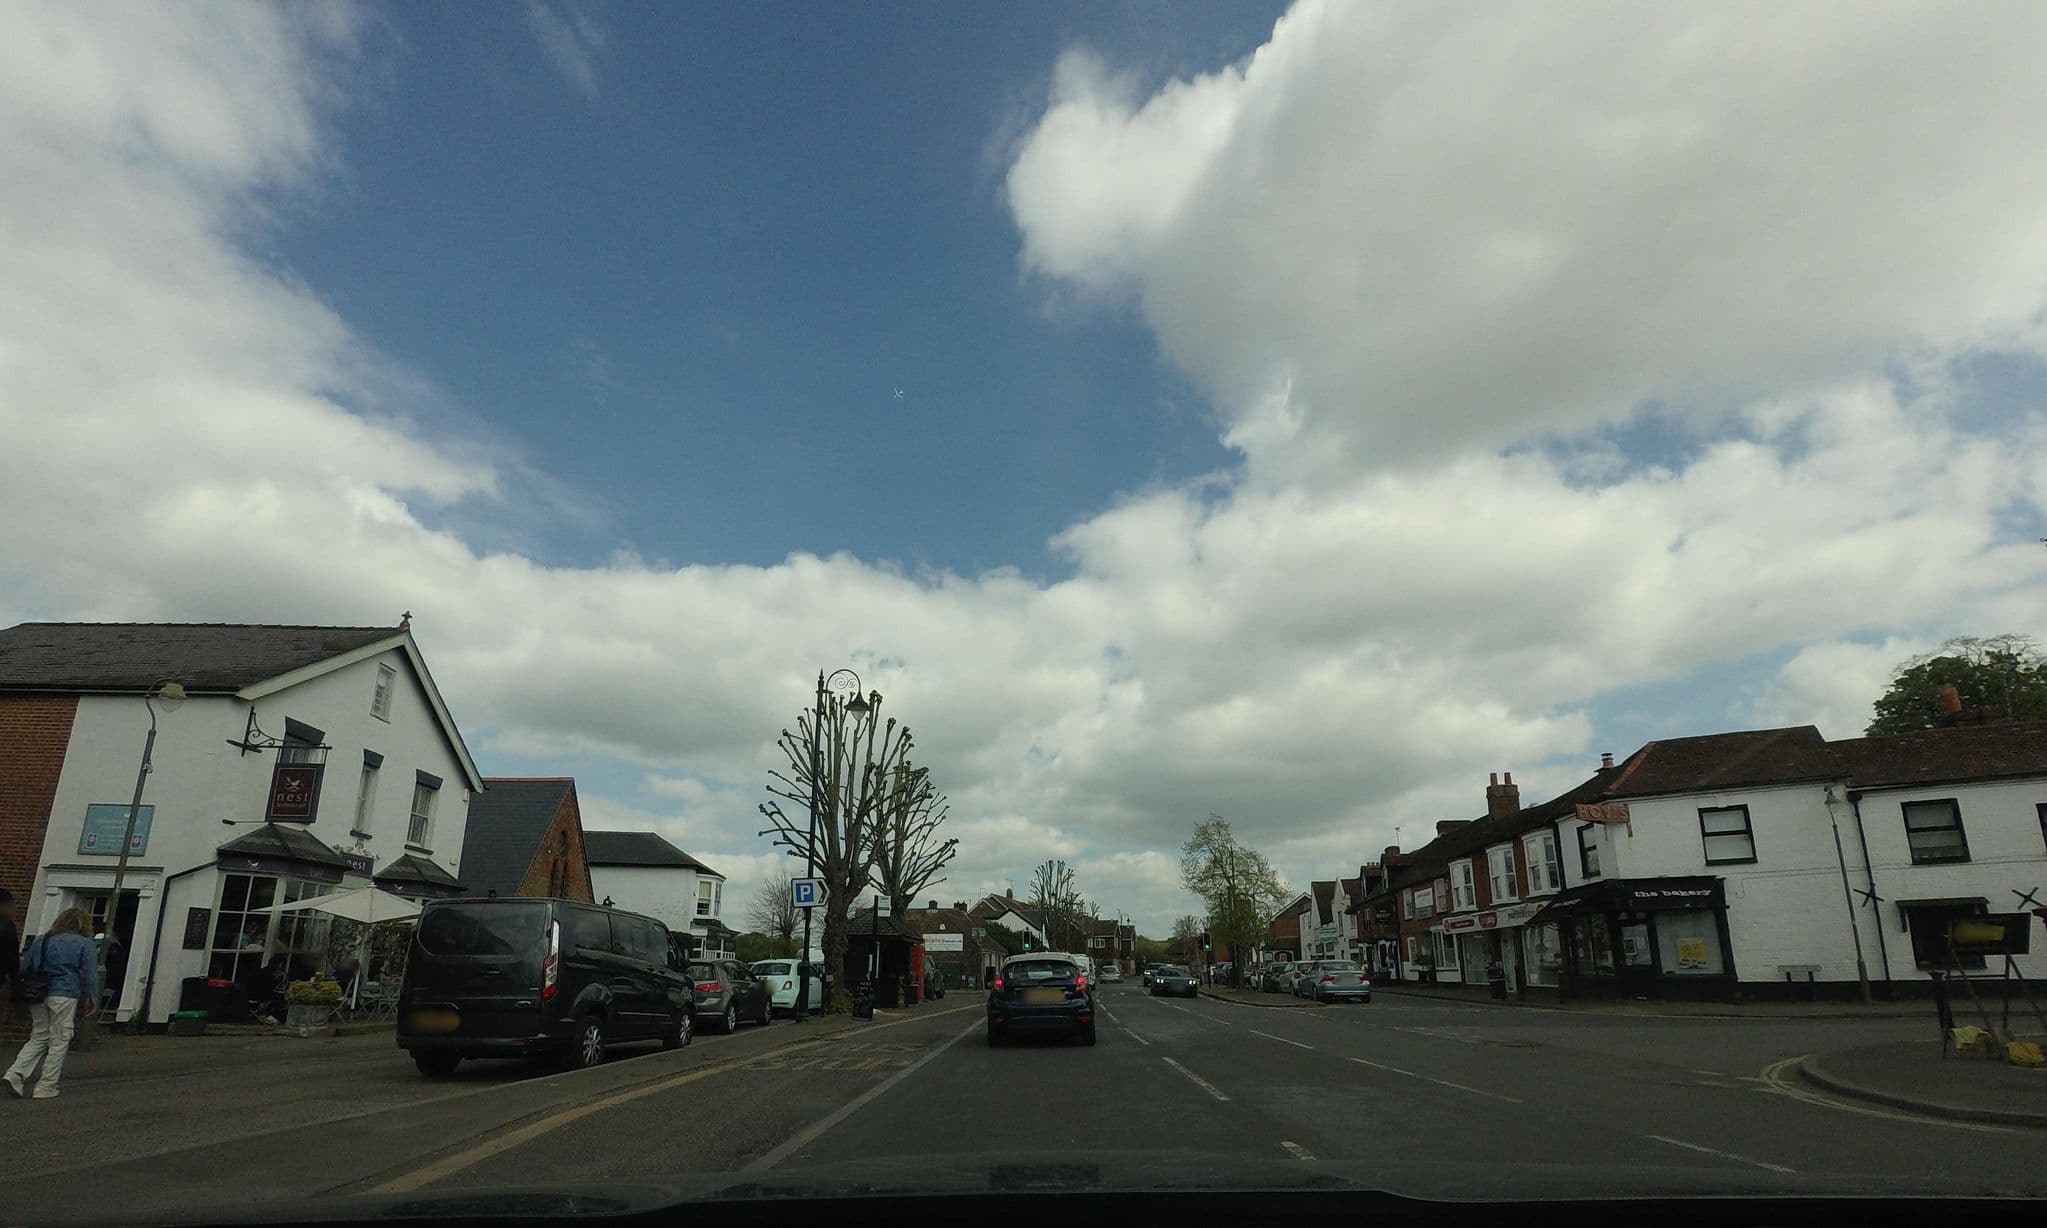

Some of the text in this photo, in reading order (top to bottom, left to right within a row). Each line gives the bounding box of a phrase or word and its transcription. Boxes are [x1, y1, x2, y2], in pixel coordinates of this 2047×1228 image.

[276, 792, 309, 803] nest
[1577, 806, 1627, 820] HOVIS
[800, 885, 811, 901] P
[1634, 889, 1712, 898] the bakery
